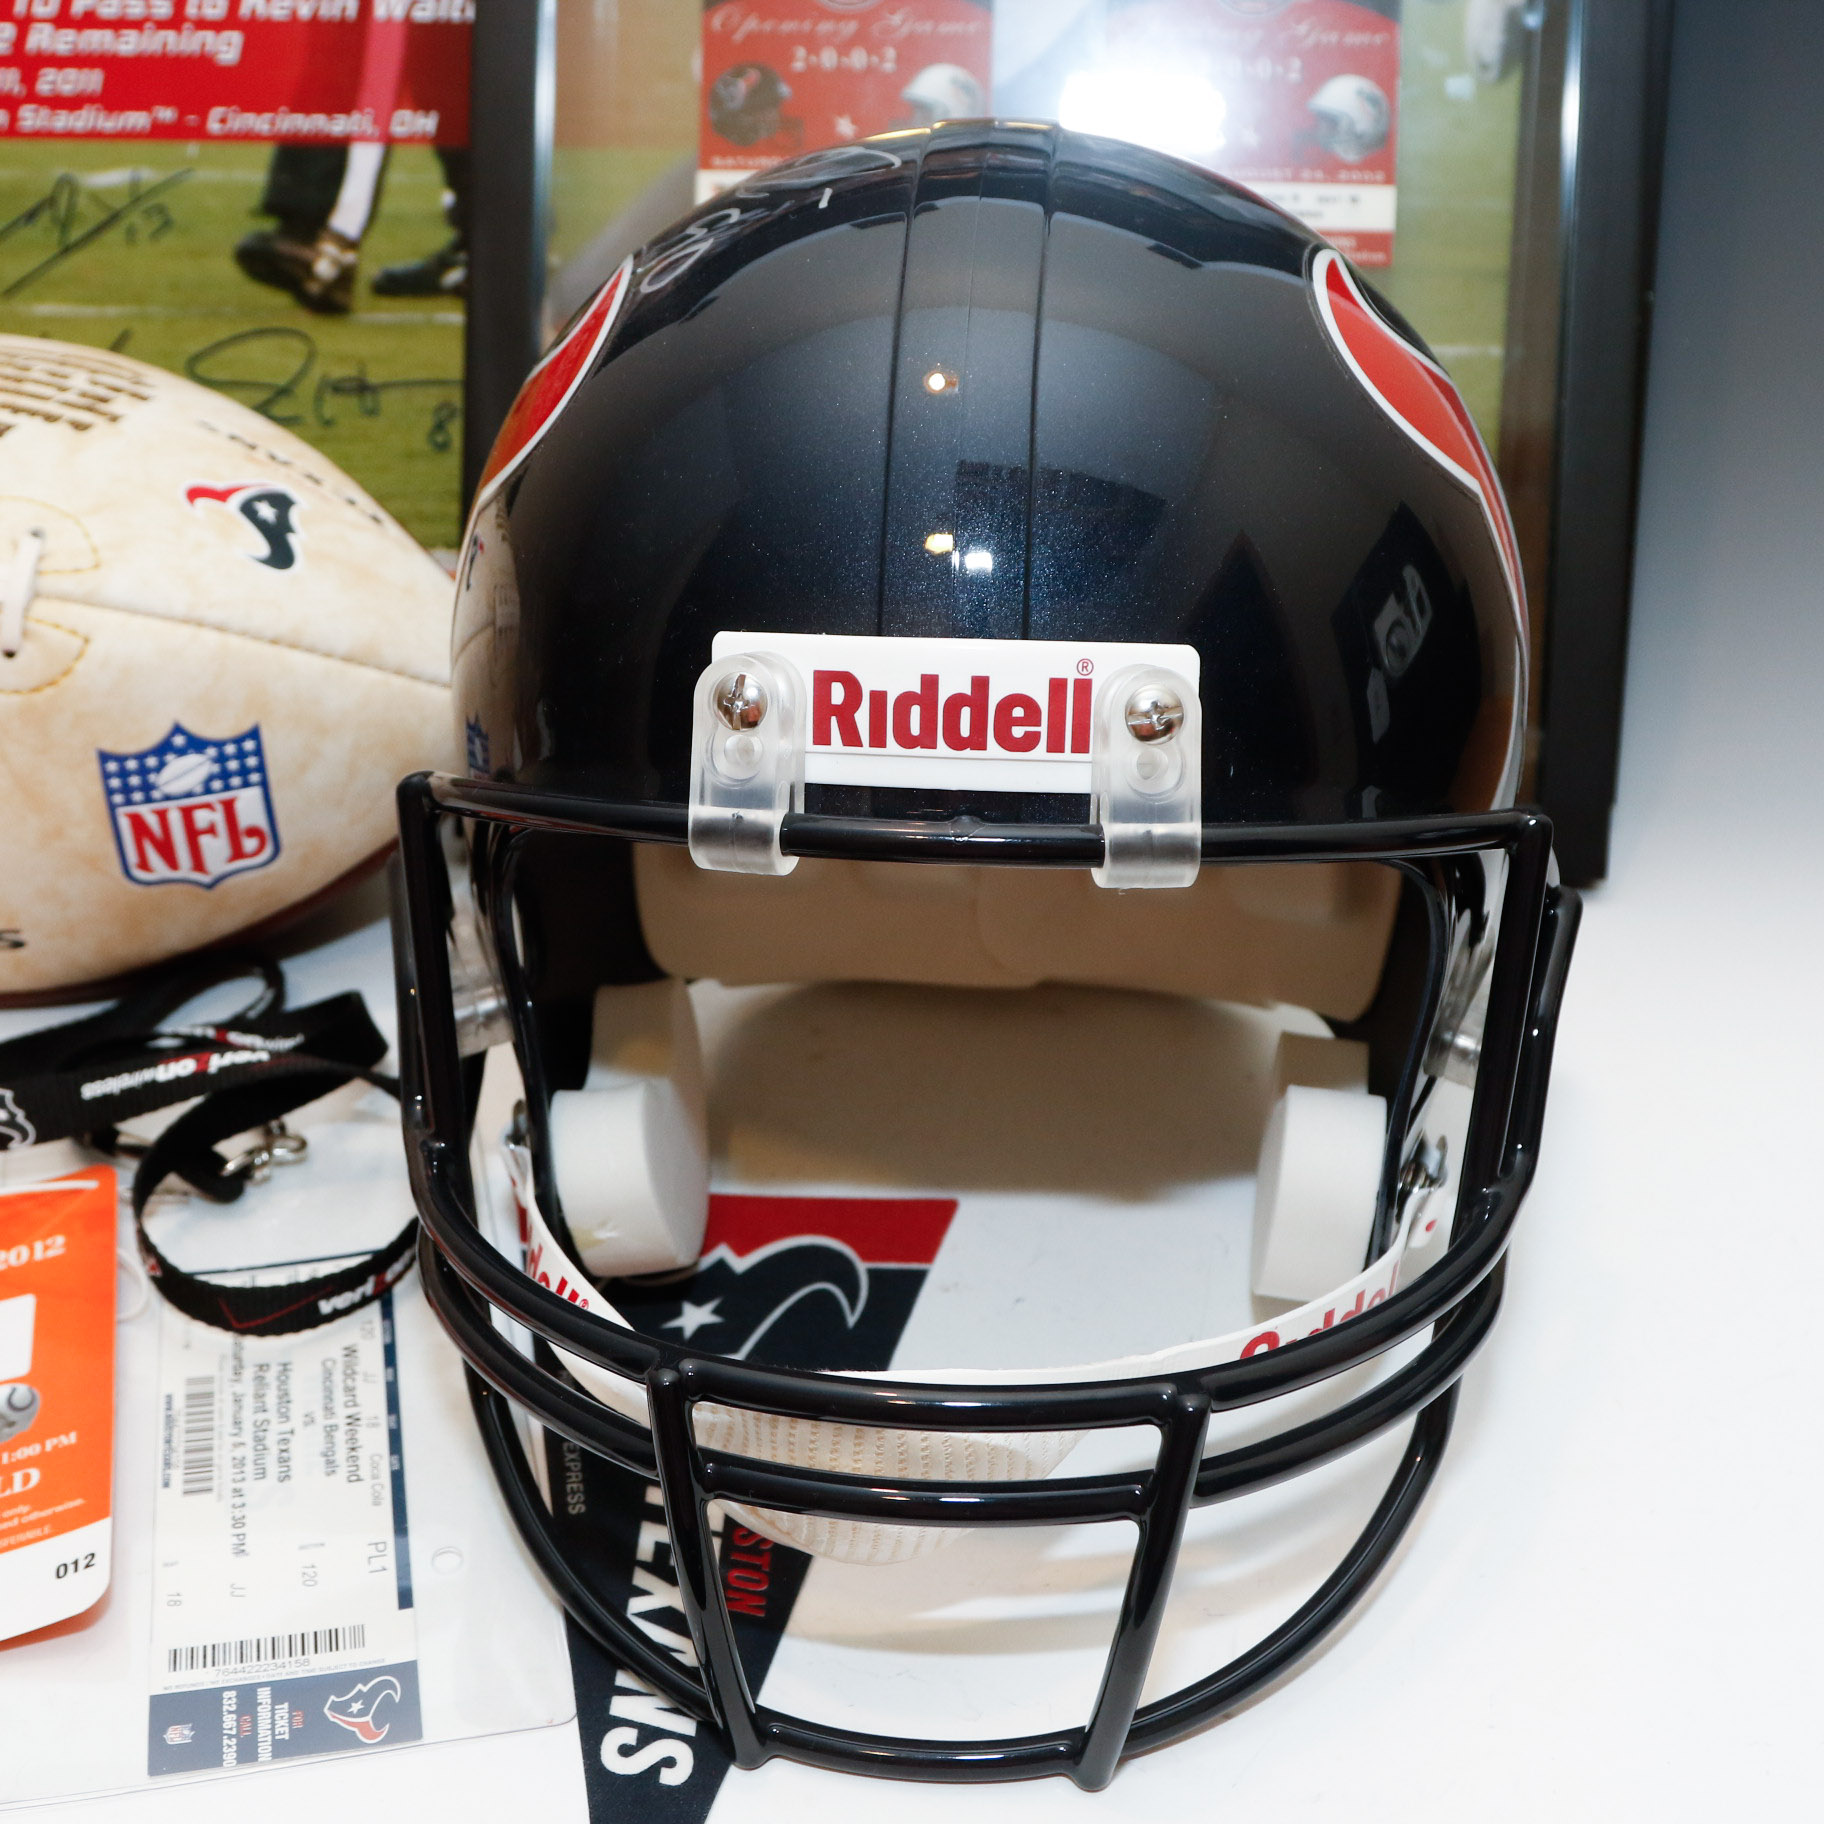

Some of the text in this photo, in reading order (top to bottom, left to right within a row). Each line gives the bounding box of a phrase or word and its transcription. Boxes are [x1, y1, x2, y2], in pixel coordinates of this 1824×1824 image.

[70, 0, 174, 20] Pass
[238, 0, 359, 22] Kevin
[25, 22, 244, 65] Remaining
[206, 105, 380, 139] Cincinnati,
[390, 109, 440, 138] OH
[125, 797, 269, 876] NFL
[228, 1391, 245, 1439] January
[252, 1362, 270, 1482] Reliant Stadium
[276, 1361, 295, 1484] Houston Texans
[321, 1358, 339, 1478] Cincinnati Bengals
[341, 1344, 364, 1484] Wildcard Weekend
[45, 1431, 78, 1452] PM
[231, 1456, 246, 1484] 2013
[369, 1453, 382, 1480] Coca
[562, 1441, 587, 1516] EXPRESS
[231, 1487, 245, 1498] at
[371, 1483, 384, 1507] Cola
[231, 1502, 246, 1529] 3:30
[231, 1533, 248, 1558] PM
[368, 1541, 388, 1575] PL1
[55, 1552, 96, 1580] 012
[301, 1563, 318, 1589] 120
[727, 1526, 775, 1618] STON
[222, 1690, 238, 1768] 832.667.2390
[256, 1686, 273, 1762] INFORMATION
[274, 1701, 290, 1741] TICKET
